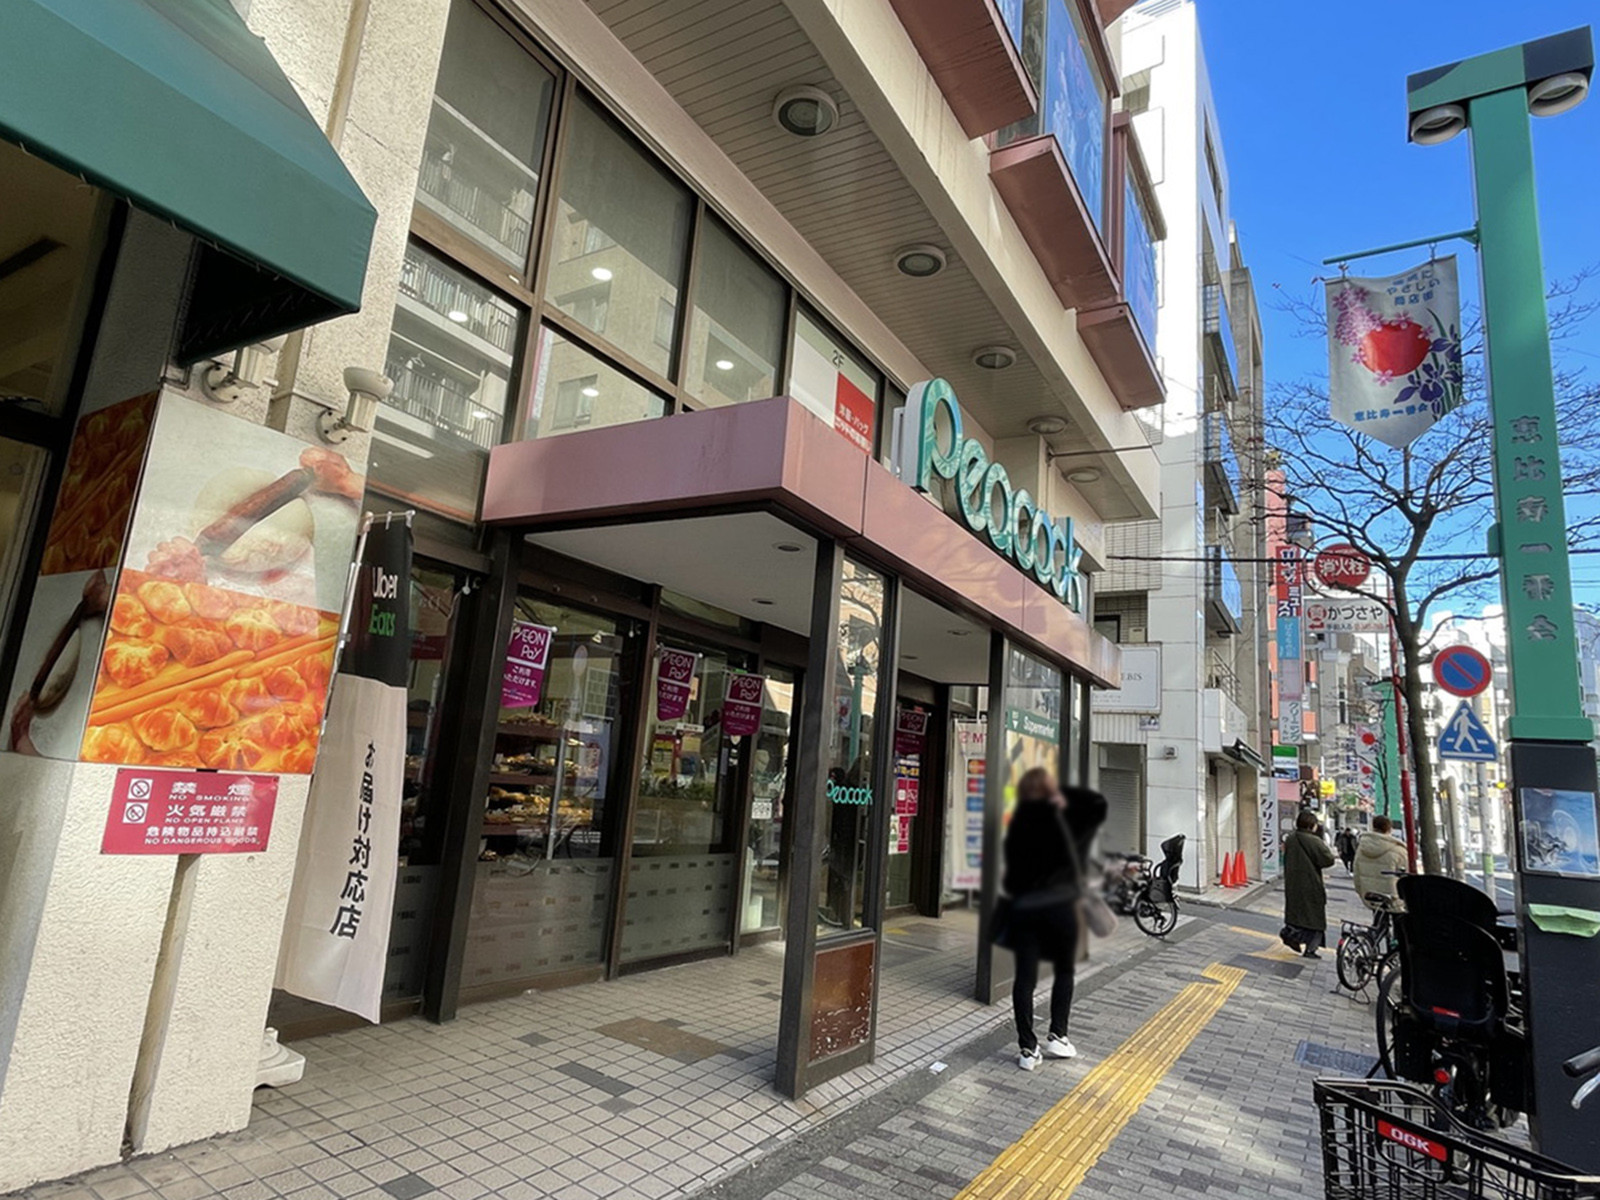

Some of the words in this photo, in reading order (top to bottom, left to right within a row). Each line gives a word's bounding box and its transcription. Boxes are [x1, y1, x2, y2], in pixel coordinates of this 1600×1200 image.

[913, 377, 1083, 614] Peacock
[1319, 556, 1368, 577] 消火栓
[372, 566, 398, 599] Uber
[368, 603, 396, 637] Eats
[1327, 604, 1384, 621] かづさや
[514, 629, 546, 647] AEON
[195, 794, 251, 802] SMOKING
[166, 804, 249, 818] 火気厳禁
[164, 817, 181, 825] NO
[213, 817, 246, 825] FLAME
[144, 837, 160, 846] NO
[162, 837, 222, 845] DANGEROUS
[329, 740, 375, 940] お届け対応店
[1390, 1127, 1430, 1153] OGK
